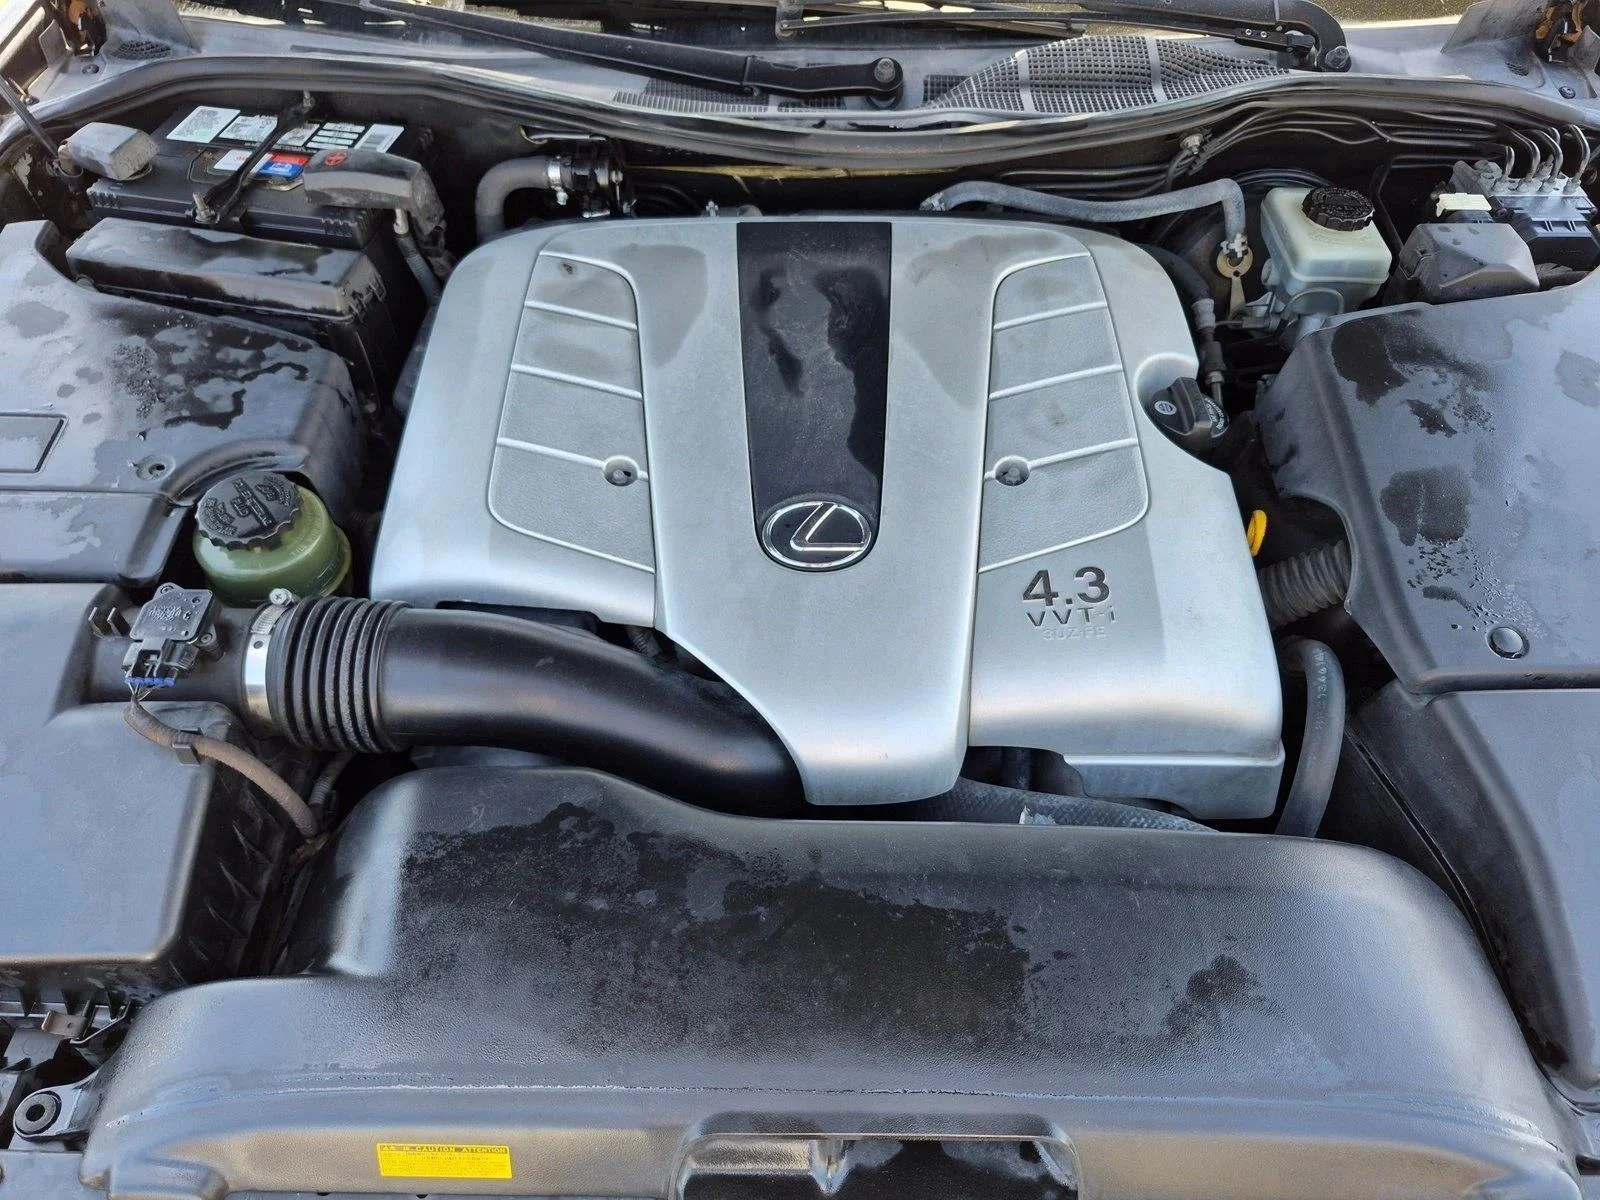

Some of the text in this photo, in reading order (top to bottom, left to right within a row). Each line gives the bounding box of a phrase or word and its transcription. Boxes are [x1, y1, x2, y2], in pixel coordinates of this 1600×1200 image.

[1022, 566, 1110, 606] 4.3
[415, 1145, 456, 1153] CAUTION
[461, 1146, 507, 1154] ATTENTION
